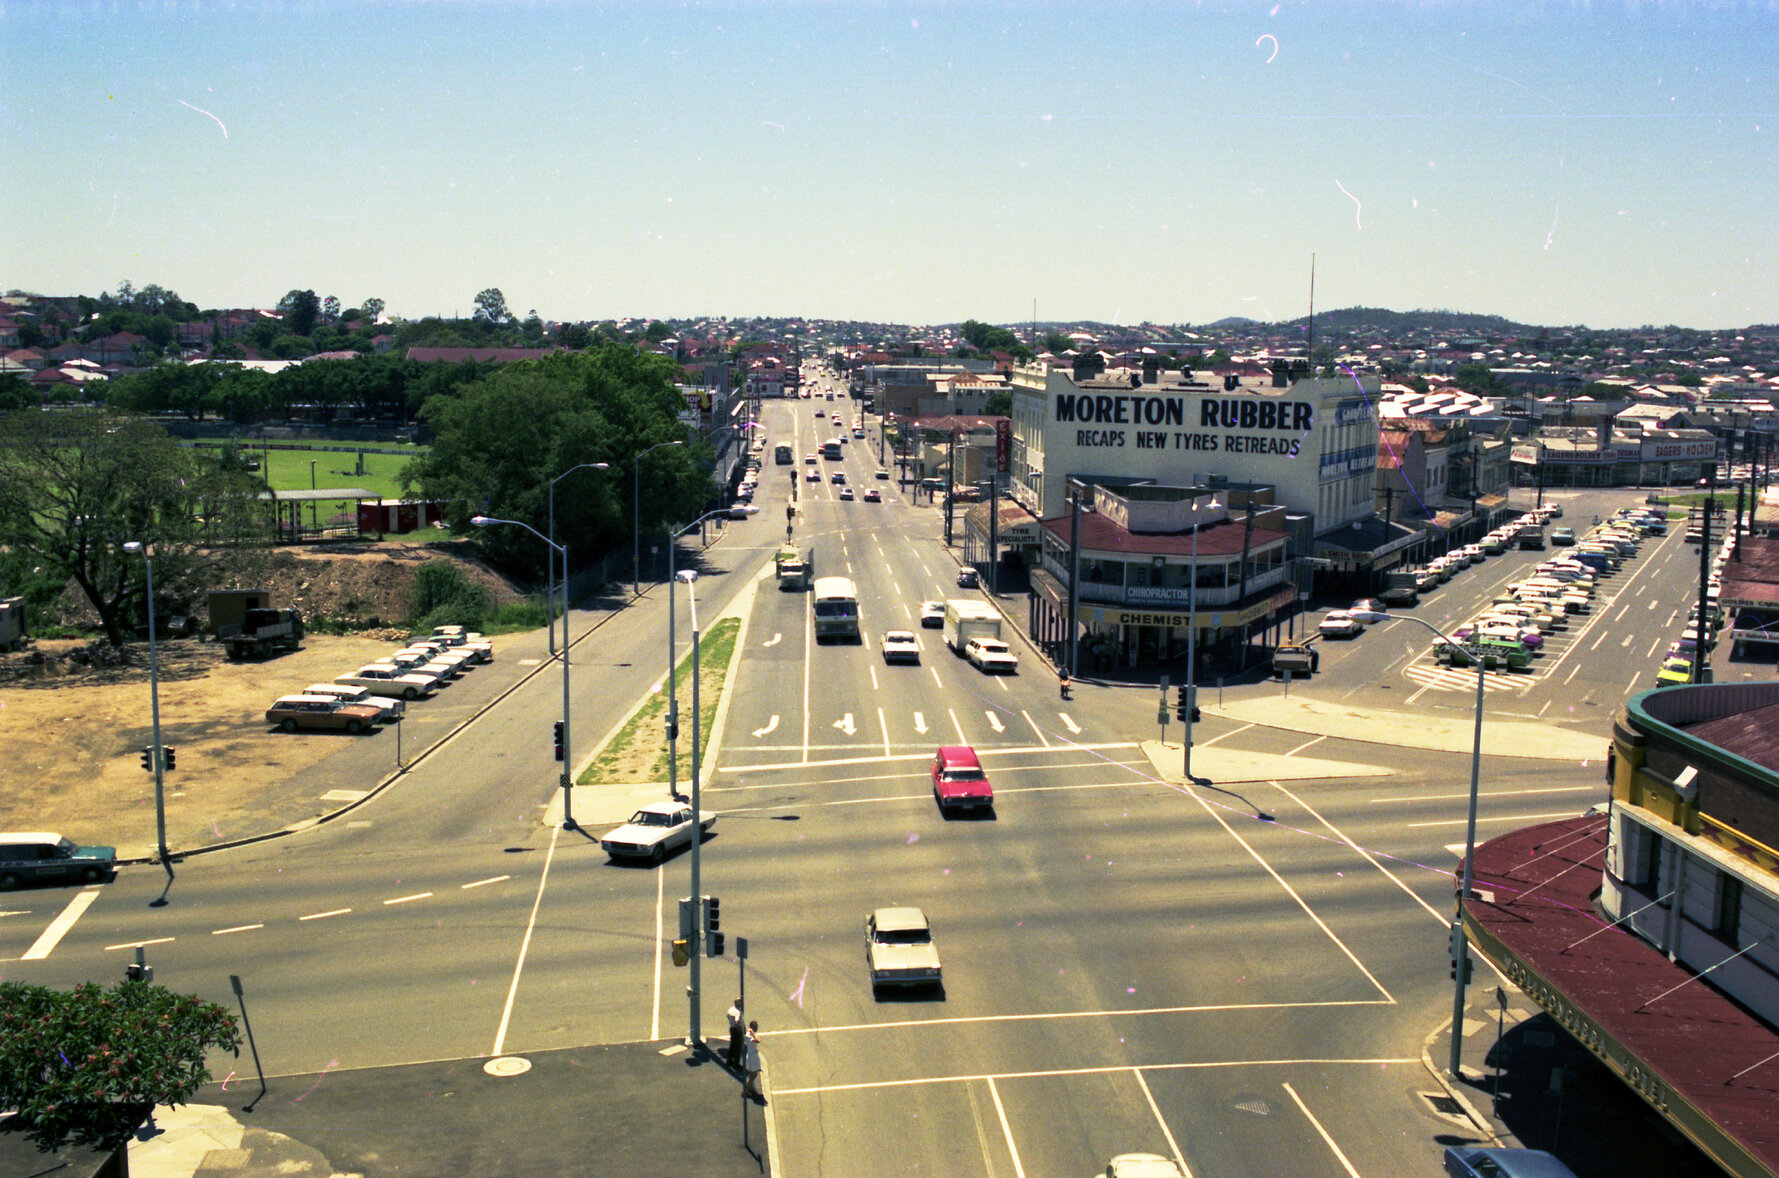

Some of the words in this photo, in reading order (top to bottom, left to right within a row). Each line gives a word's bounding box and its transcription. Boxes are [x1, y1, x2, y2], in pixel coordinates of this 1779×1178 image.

[1056, 394, 1184, 426] MORETON
[1200, 399, 1312, 431] RUBBER
[1076, 430, 1125, 447] RECAPS
[1137, 431, 1167, 449] NEW
[1175, 432, 1218, 451] TYRES
[1225, 435, 1301, 456] RETREADS
[1328, 550, 1349, 558] SMITH
[1127, 586, 1188, 600] CHIROPRACTOR
[1120, 613, 1191, 626] CHEMIST
[1503, 952, 1607, 1058] WOOLLOONGABBA
[1622, 1056, 1668, 1110] HOTEL
